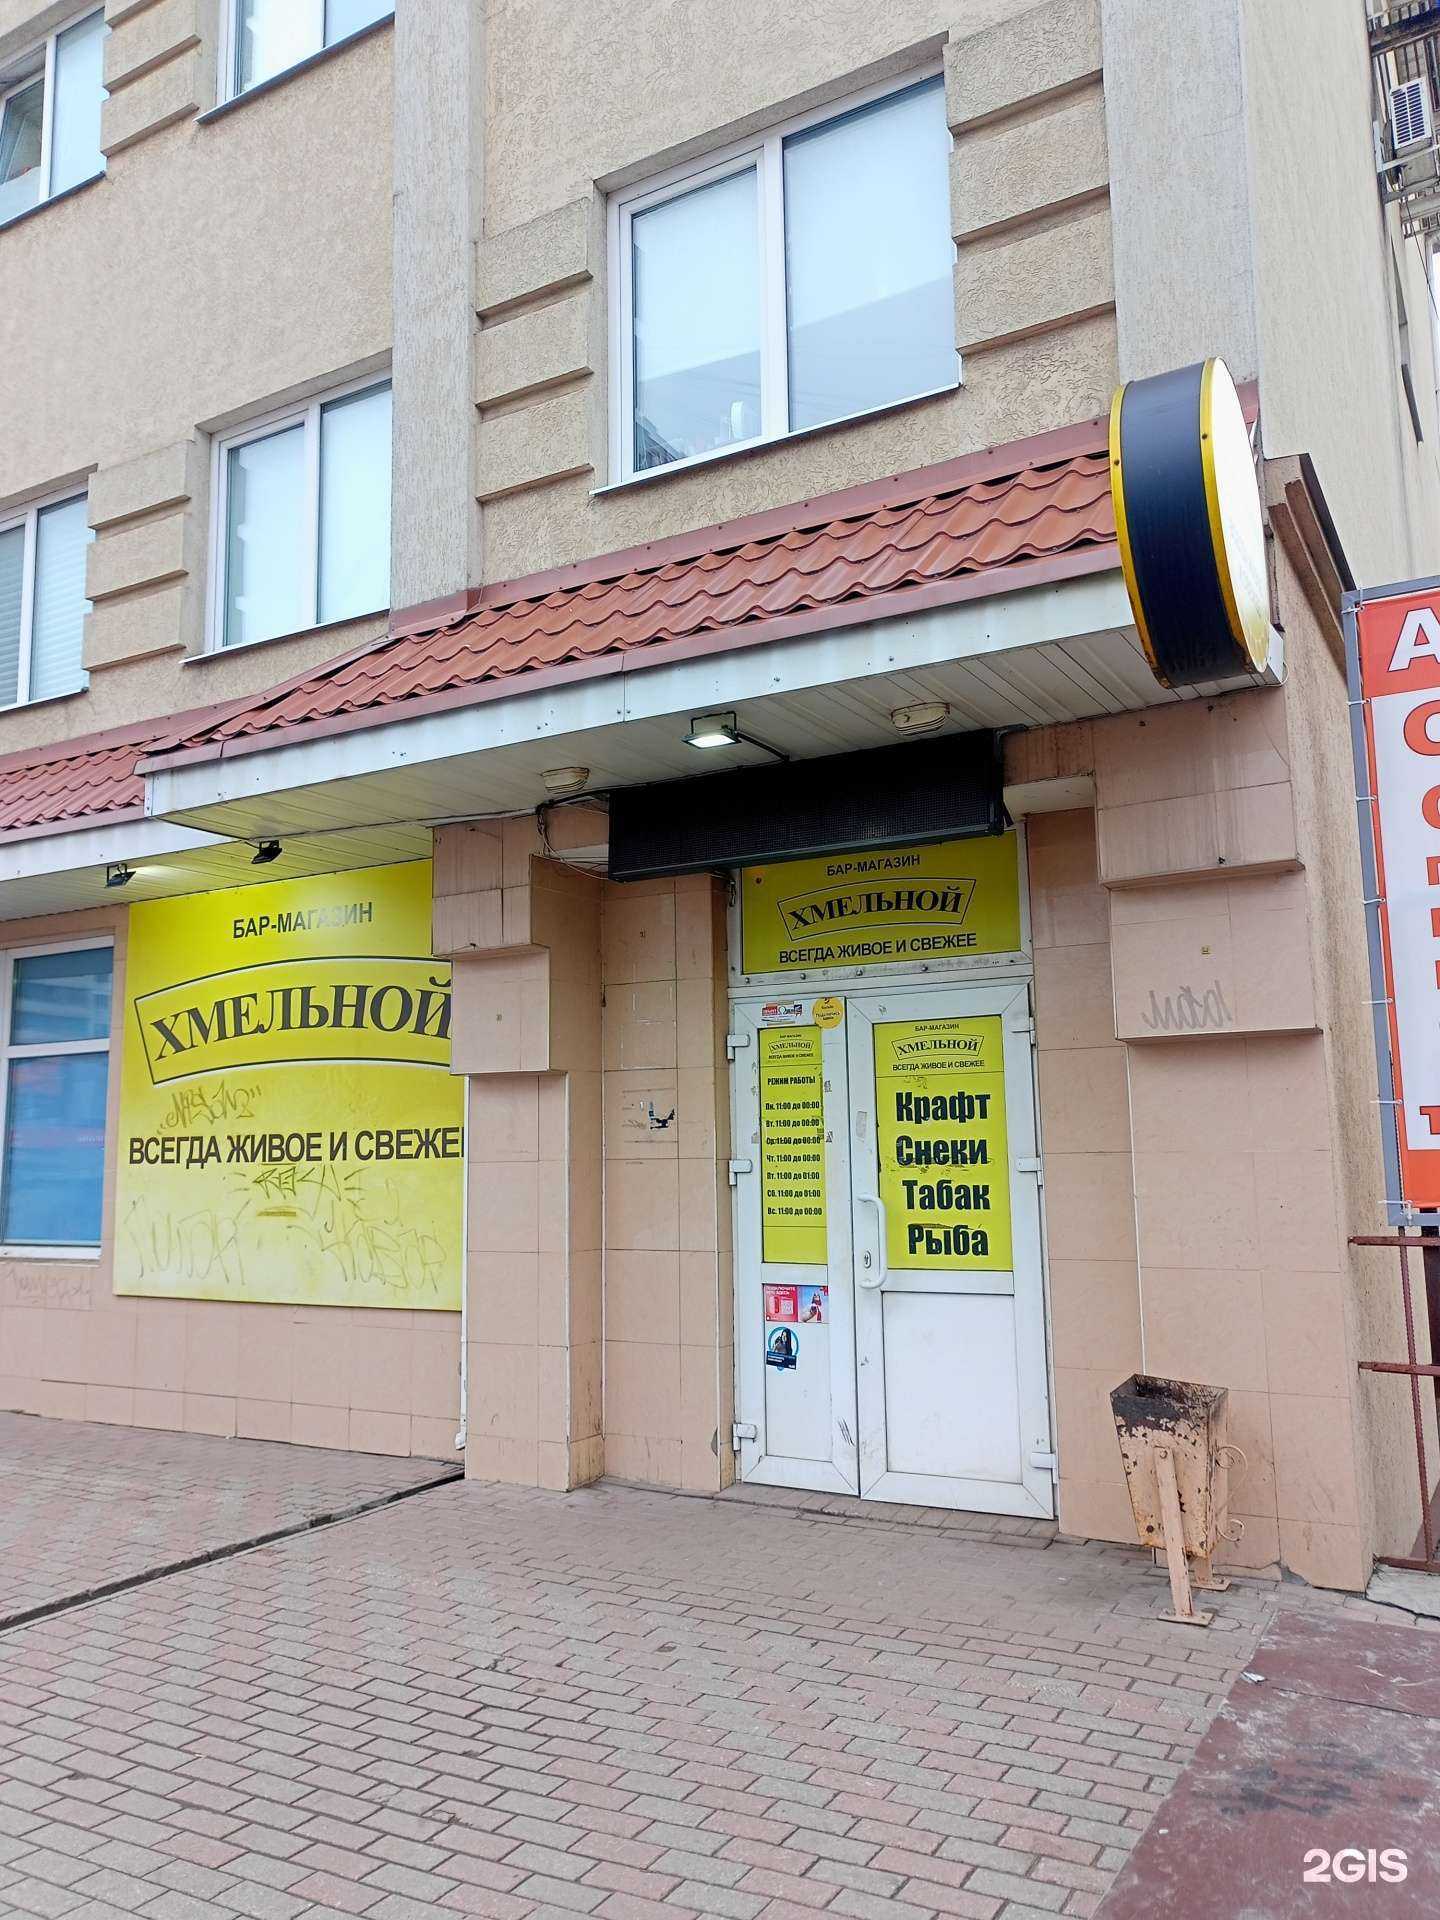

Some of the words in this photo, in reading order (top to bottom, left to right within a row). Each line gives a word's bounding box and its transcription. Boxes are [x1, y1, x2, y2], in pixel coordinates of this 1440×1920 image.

[827, 855, 920, 876] БАР-МАГАЗИН
[787, 885, 965, 931] ХМЕЛЬНОЙ
[232, 902, 373, 939] БАР-МАГАЗИН
[779, 947, 834, 963] ВСЕГДА
[837, 941, 892, 958] ЖИВОЕ
[896, 939, 906, 953] И
[911, 933, 977, 952] СВЕЖЕЕ
[150, 976, 451, 1062] ХМЕЛЬНОЙ
[915, 1024, 960, 1032] БАР-МАГАЗИН
[897, 1038, 979, 1055] ХМЕЛЬНОЙ
[892, 1063, 919, 1071] ВСЕГДА
[920, 1062, 947, 1070] ЖИВОЕ
[954, 1060, 985, 1068] СВЕЖЕЕ
[767, 1077, 789, 1086] РЕЖИМ
[790, 1076, 816, 1085] РАБОТЫ
[776, 1102, 791, 1110] 11:00
[802, 1101, 820, 1109] 00:00
[895, 1091, 991, 1125] Крафт
[776, 1119, 791, 1127] 11:00
[801, 1119, 820, 1127] 00:00
[129, 1135, 222, 1169] ВСЕГДА
[226, 1131, 322, 1163] ЖИВОЕ
[329, 1131, 348, 1162] И
[354, 1127, 464, 1161] СВЕЖЕ
[776, 1137, 792, 1145] 11:00
[802, 1136, 820, 1144] 00:00
[766, 1154, 775, 1162] Чт.
[776, 1154, 792, 1162] 11:00
[792, 1155, 801, 1163] до
[802, 1154, 821, 1162] 00:00
[895, 1135, 988, 1166] Снеки
[777, 1172, 792, 1180] 11:00
[793, 1173, 802, 1181] до
[803, 1172, 820, 1180] 01:00
[778, 1189, 793, 1197] 11:00
[902, 1179, 991, 1210] Табак
[778, 1207, 794, 1215] 11:00
[794, 1208, 804, 1216] до
[804, 1207, 823, 1215] 00:00
[908, 1223, 989, 1256] Рыба
